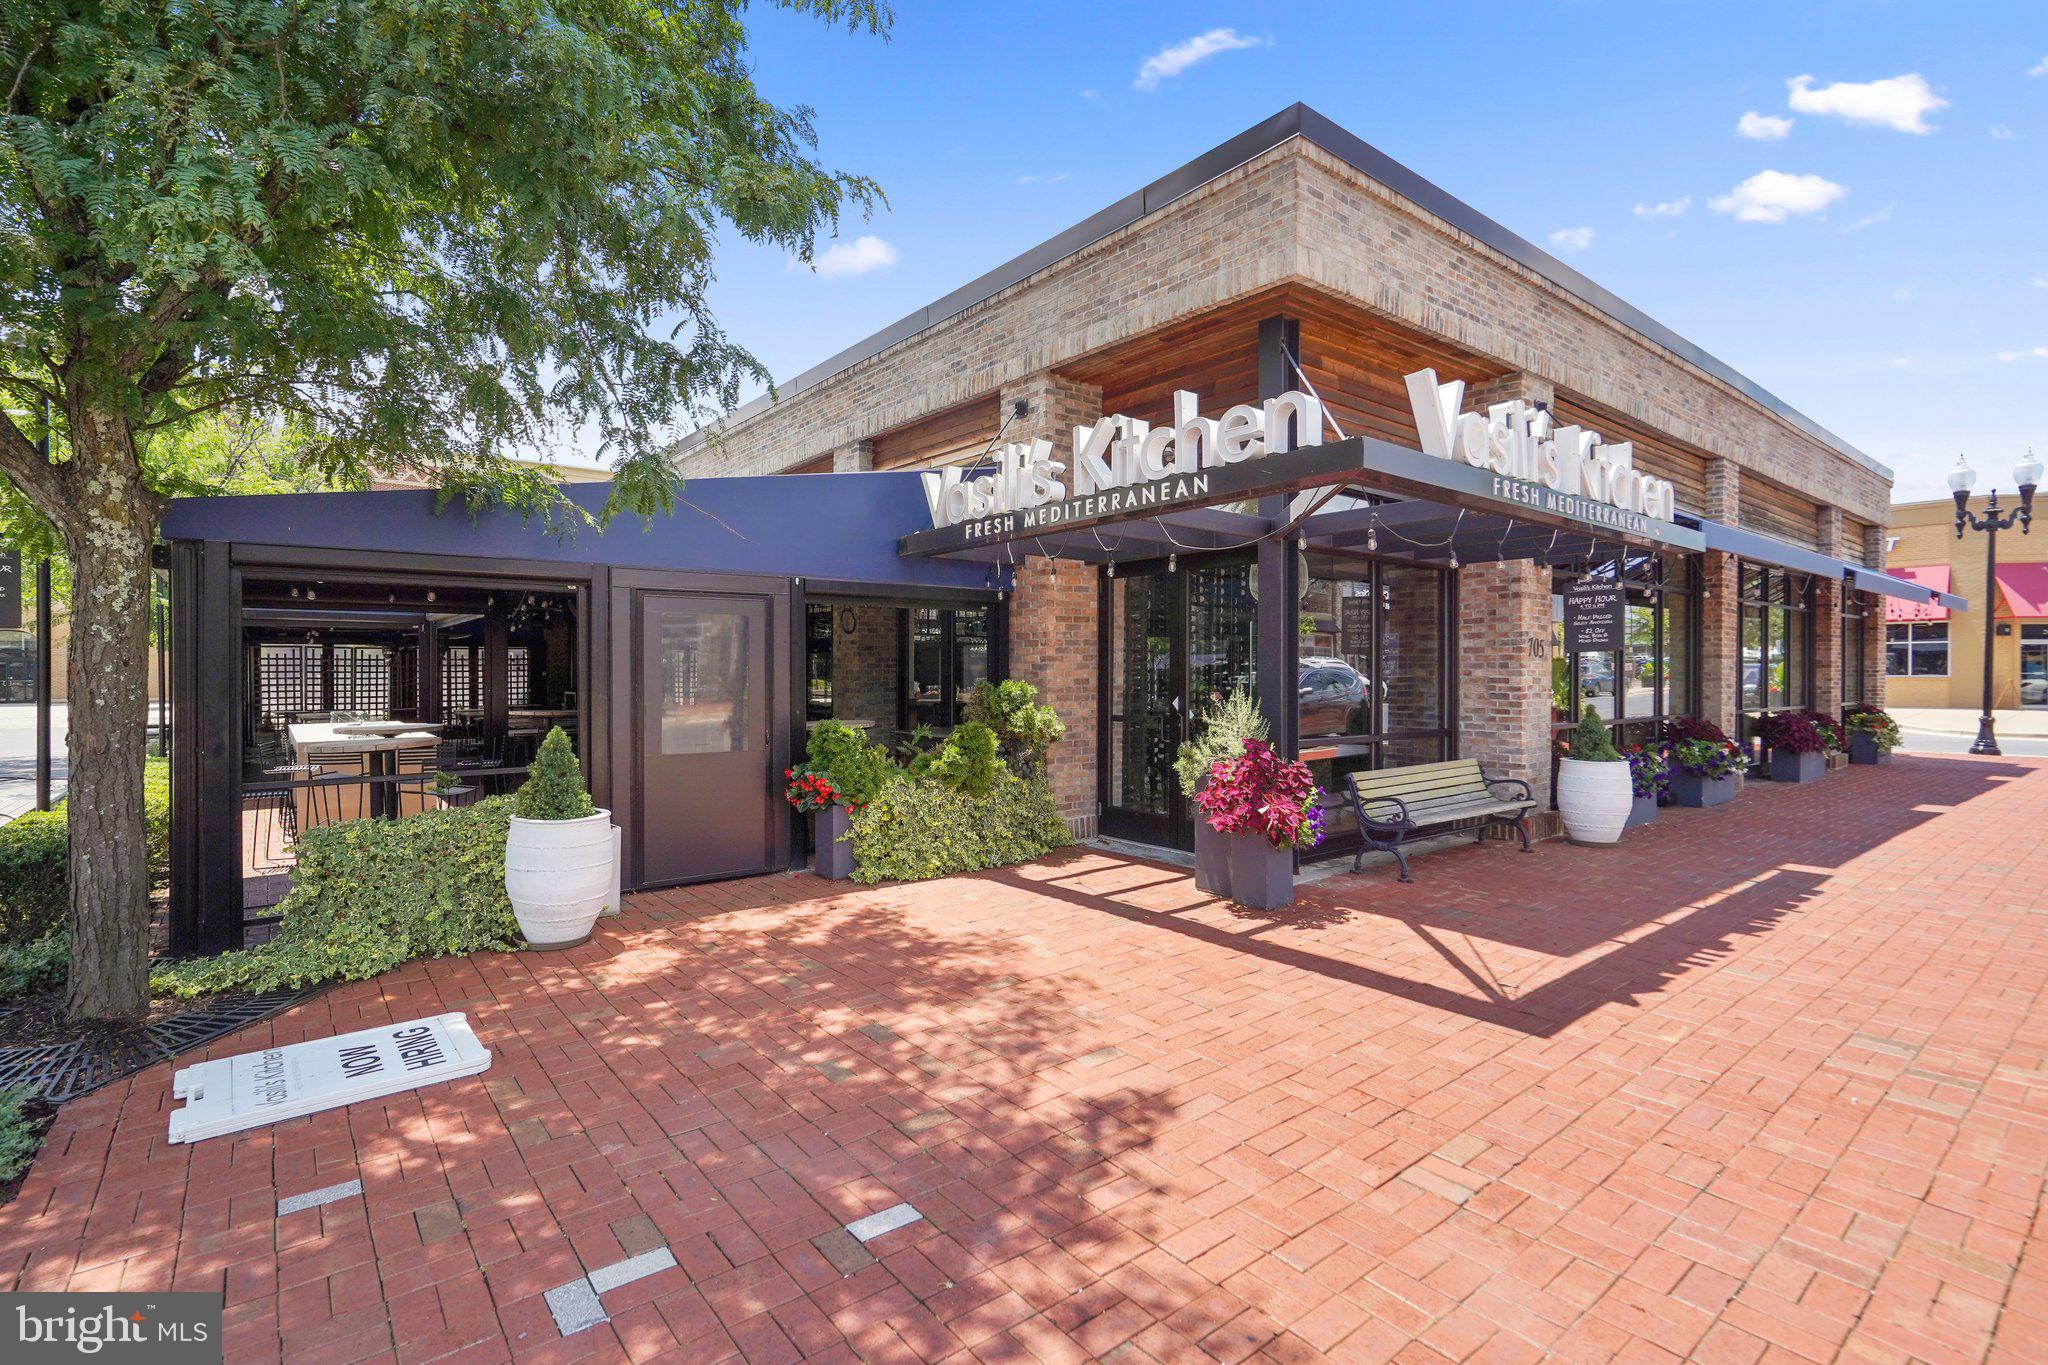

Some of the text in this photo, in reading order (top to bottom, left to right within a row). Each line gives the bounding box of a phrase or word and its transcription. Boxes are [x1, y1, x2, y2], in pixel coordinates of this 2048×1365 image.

[920, 389, 1323, 529] Vasili's Kitchen
[964, 474, 1209, 540] FRESH MEDITERRANEAN
[1493, 477, 1648, 533] FRESH MEDITERRANEAN
[1568, 595, 1617, 605] HAPPY HOUR
[1527, 637, 1545, 659] 705
[338, 1044, 385, 1079] NOW
[392, 1026, 447, 1071] HIRING
